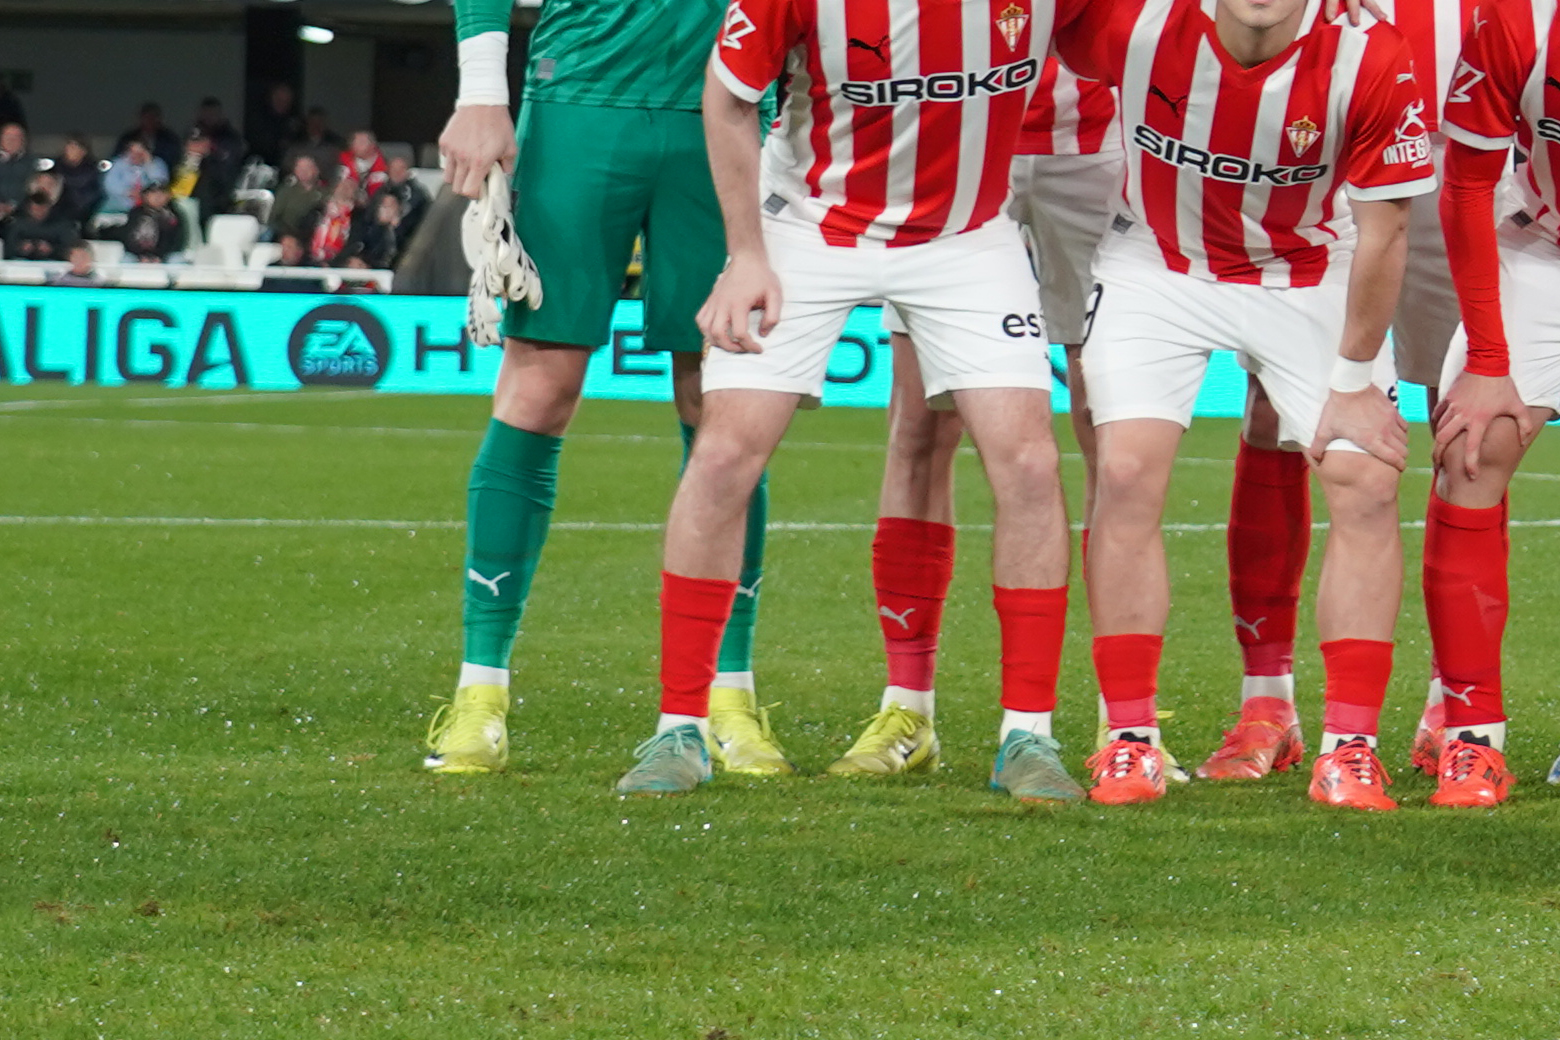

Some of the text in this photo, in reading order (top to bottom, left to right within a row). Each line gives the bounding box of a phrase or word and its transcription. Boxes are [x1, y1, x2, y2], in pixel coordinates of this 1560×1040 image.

[840, 58, 1038, 106] SIROKO
[1134, 123, 1329, 186] SIROKO
[0, 305, 247, 386] LIGA
